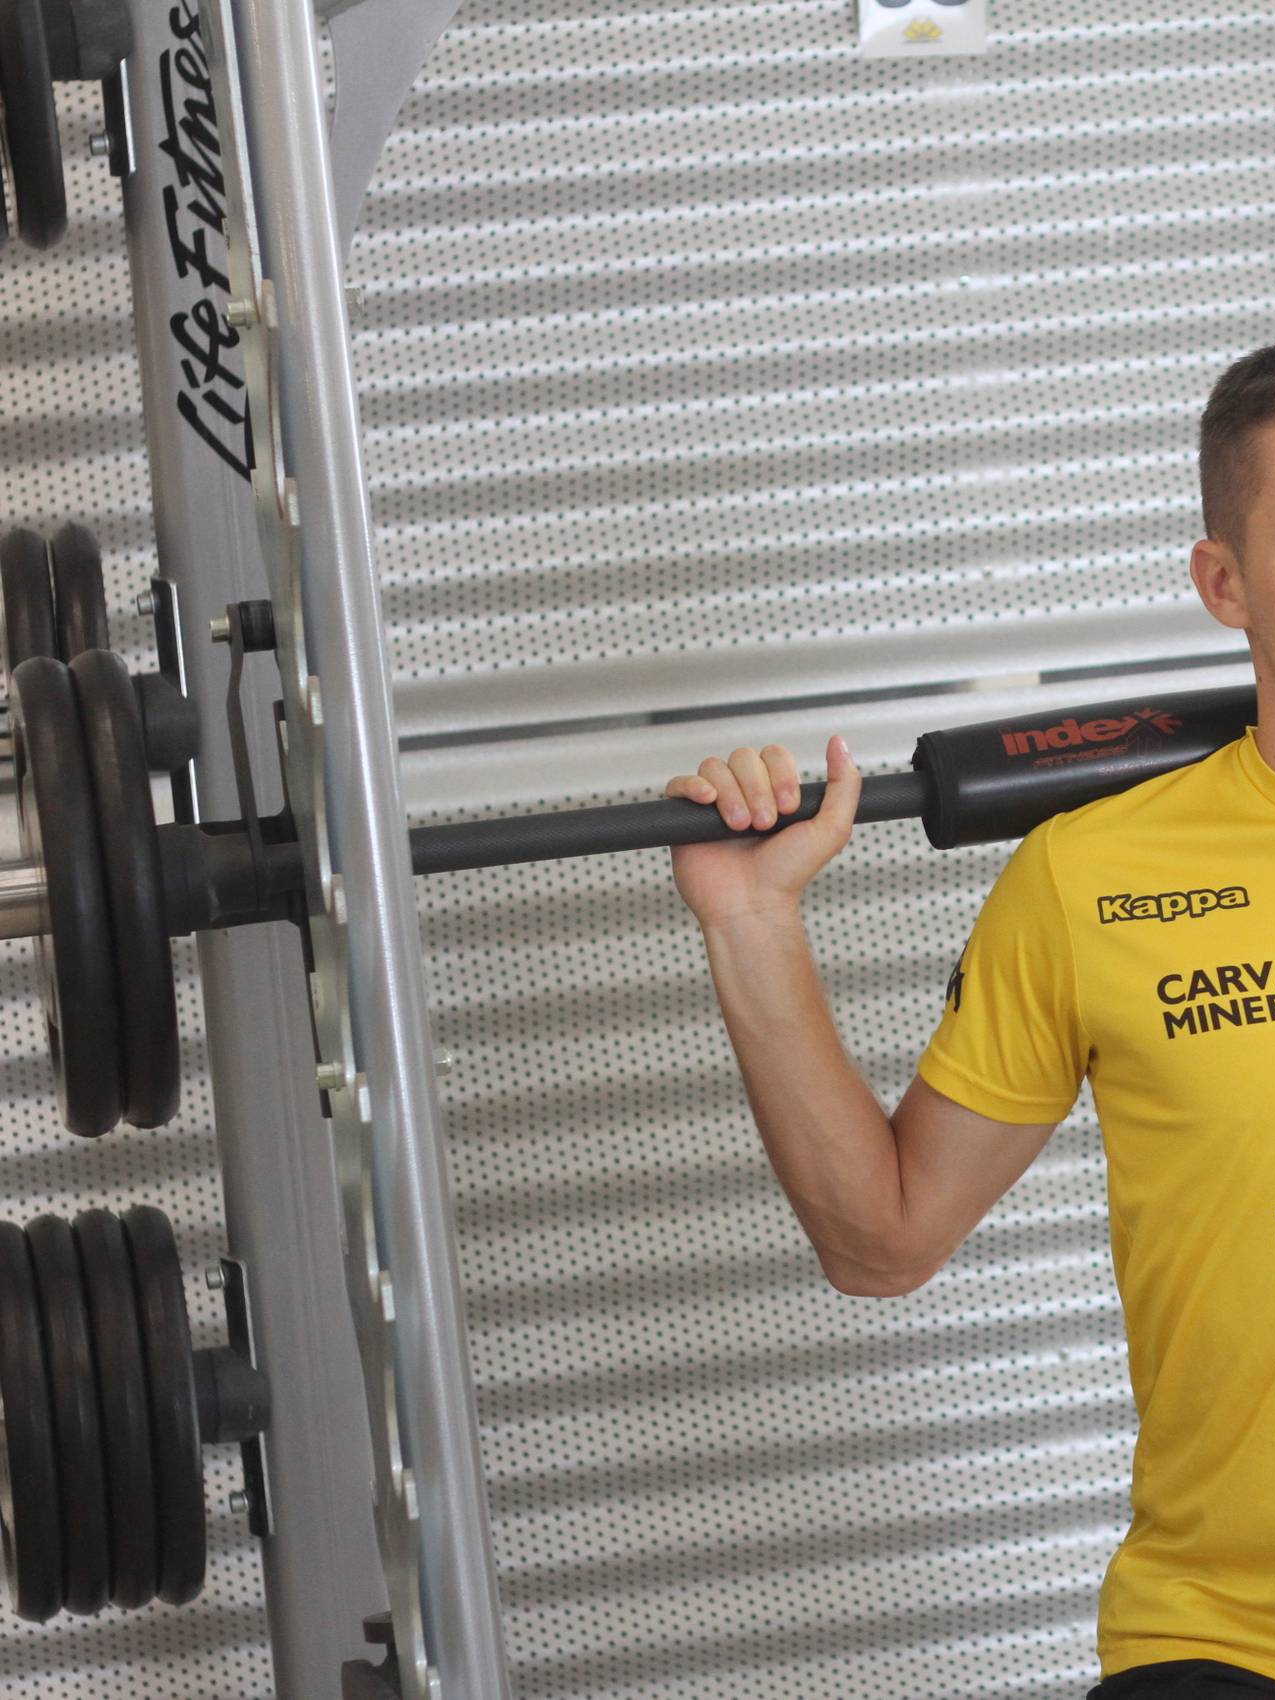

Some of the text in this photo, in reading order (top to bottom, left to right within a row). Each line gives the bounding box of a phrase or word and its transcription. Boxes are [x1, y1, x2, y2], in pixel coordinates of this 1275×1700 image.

[159, 0, 257, 482] Life Fitnes
[1098, 886, 1249, 923] Kappa
